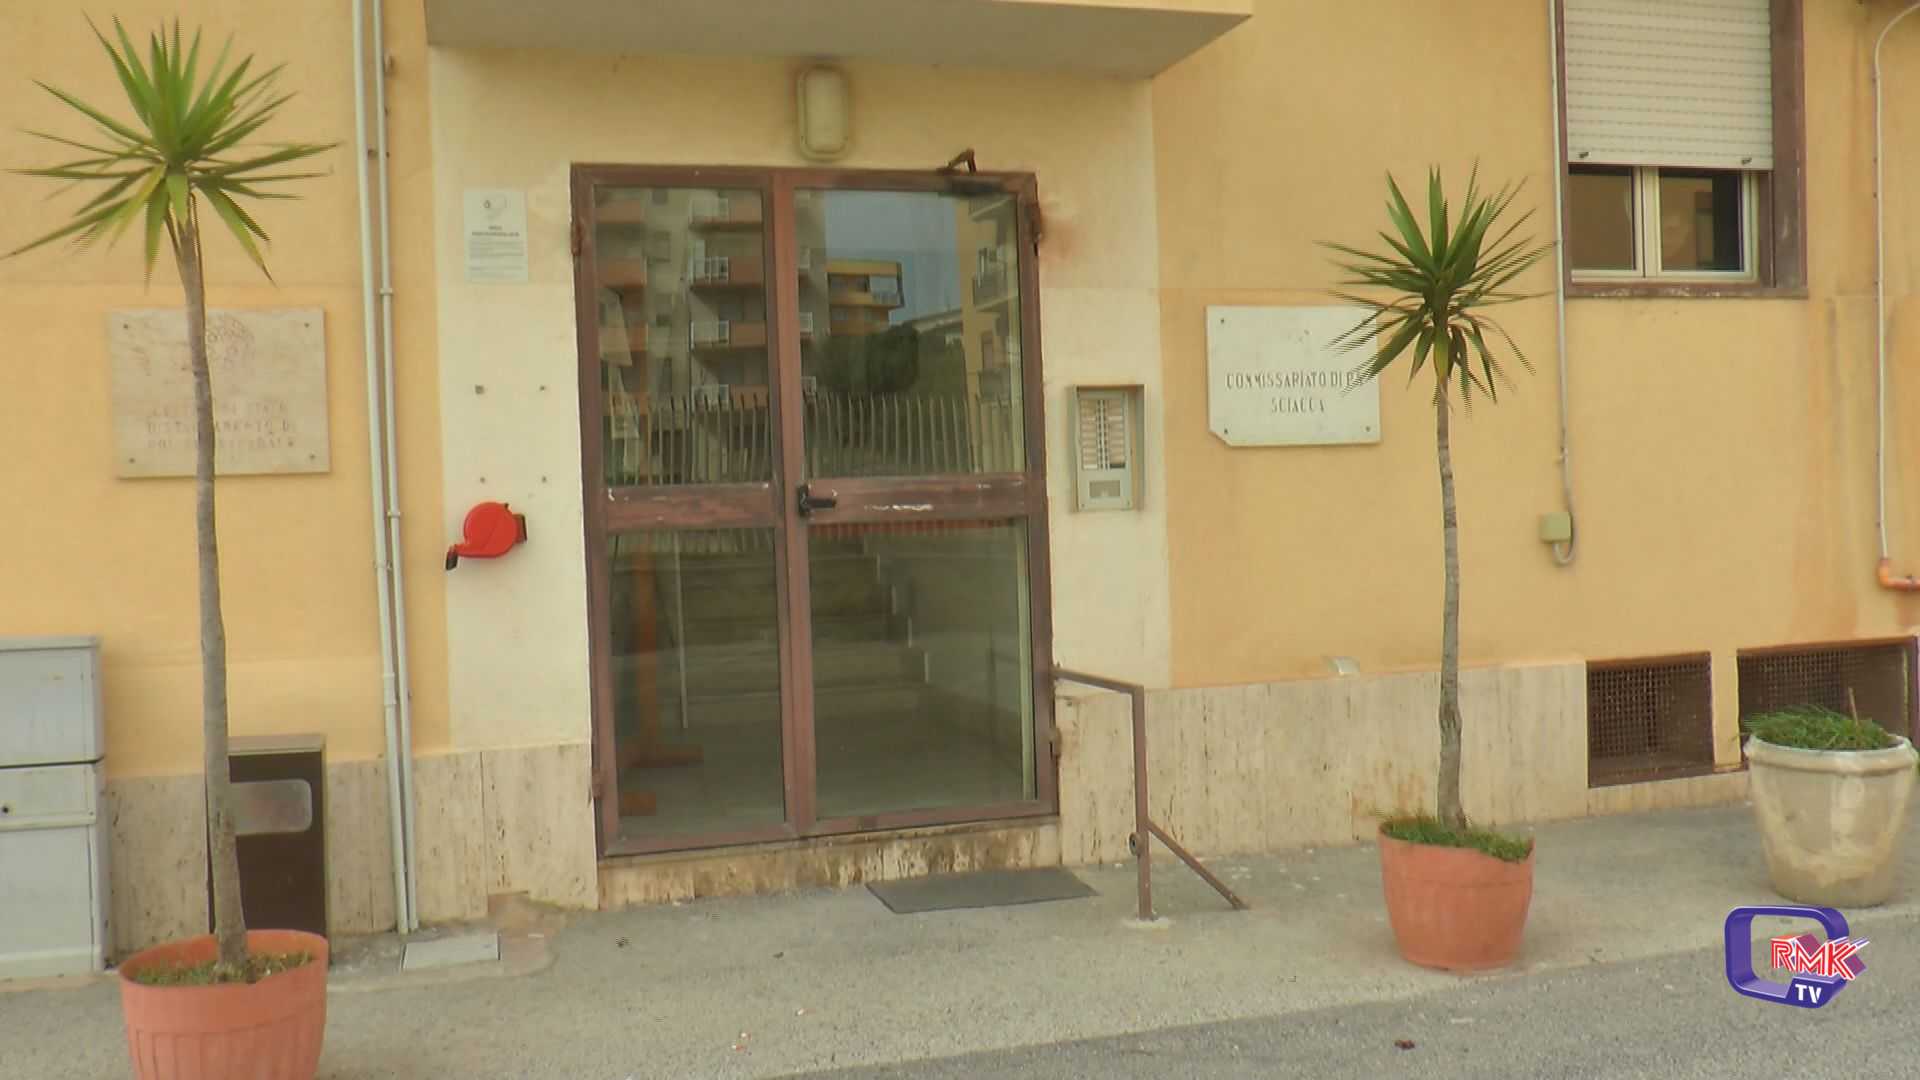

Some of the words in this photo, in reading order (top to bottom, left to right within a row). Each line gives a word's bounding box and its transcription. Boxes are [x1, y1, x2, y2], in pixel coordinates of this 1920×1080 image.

[1226, 370, 1327, 389] COMMISSARIATO
[1330, 370, 1343, 387] DI
[1271, 396, 1326, 414] SCIACCA
